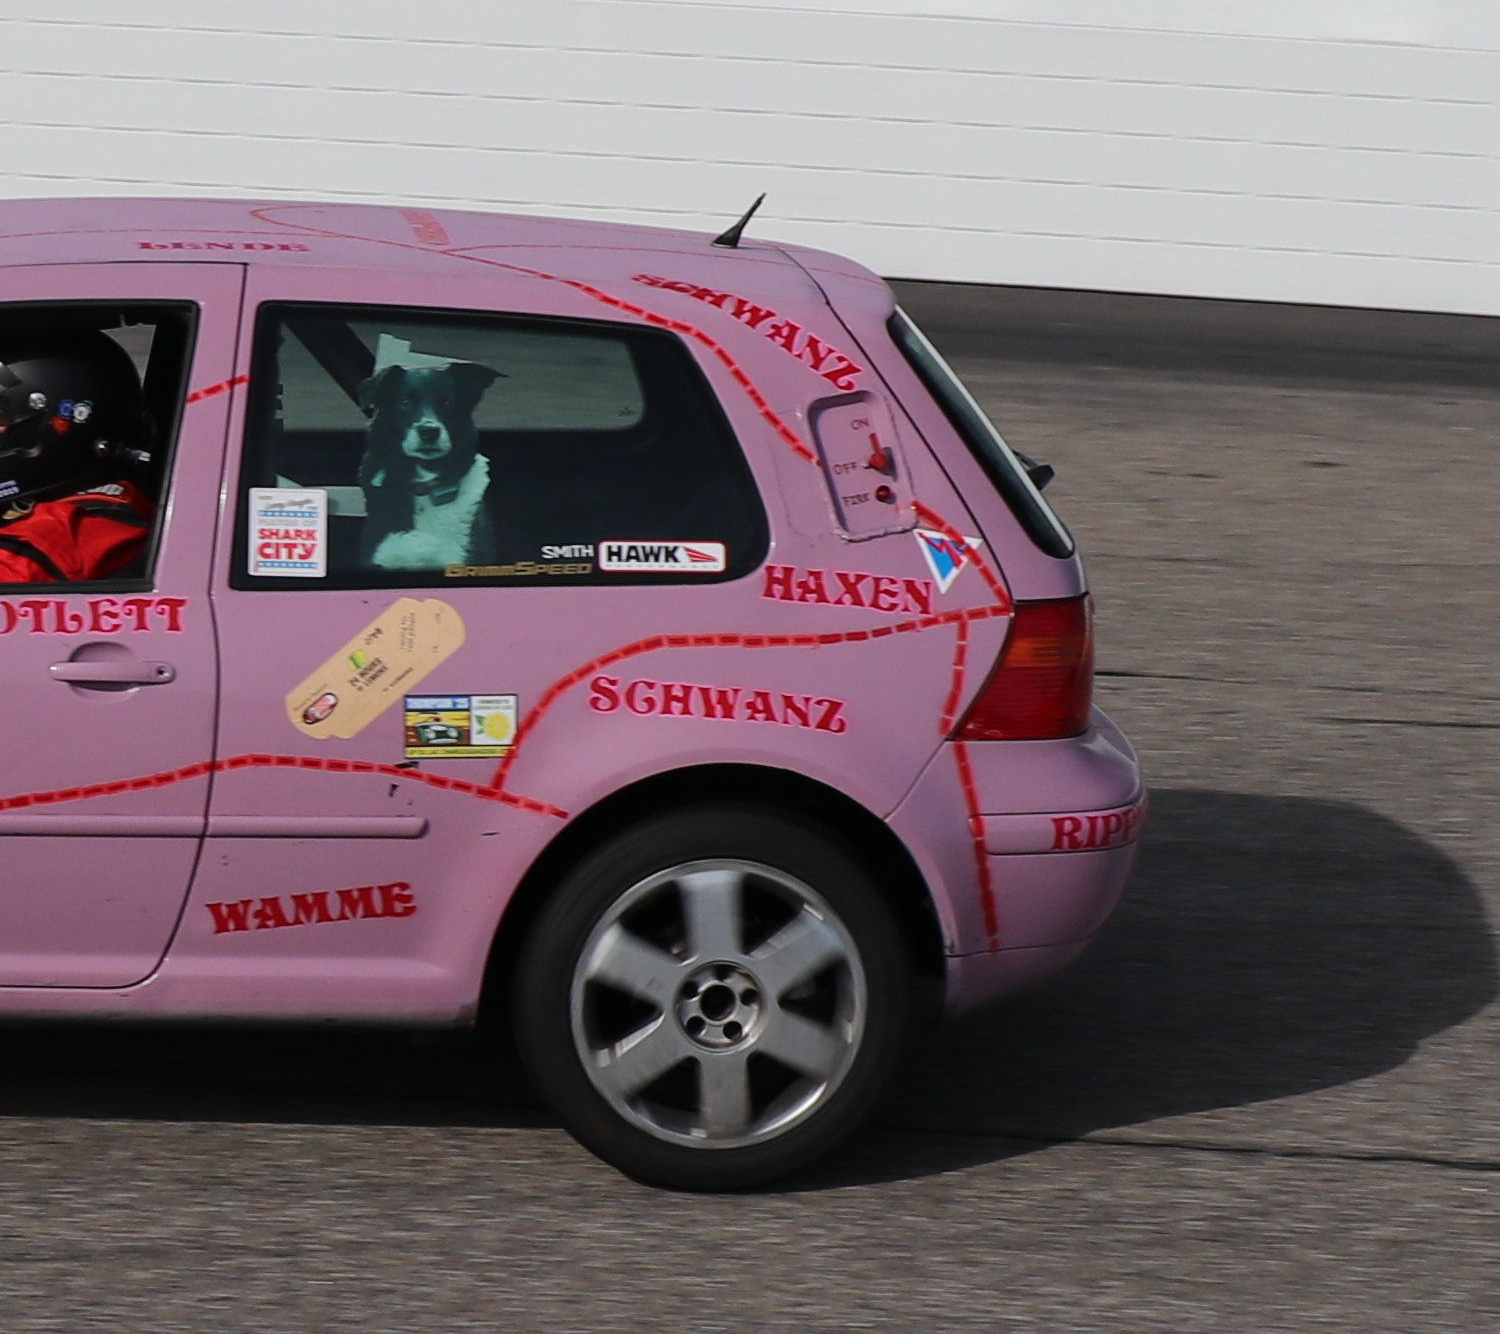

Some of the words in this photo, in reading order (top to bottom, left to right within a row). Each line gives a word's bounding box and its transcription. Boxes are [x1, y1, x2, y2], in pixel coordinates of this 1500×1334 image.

[137, 242, 310, 252] LENDE
[631, 274, 863, 391] SCHWANZ
[851, 418, 870, 430] ON
[833, 461, 858, 475] OFF
[258, 528, 318, 541] SHARK
[257, 542, 318, 560] CITY
[541, 545, 594, 559] SMITH
[606, 545, 681, 563] HAWK
[763, 565, 932, 616] HAXEN
[588, 675, 850, 735] SCHWANZ
[205, 881, 417, 936] WAMME
